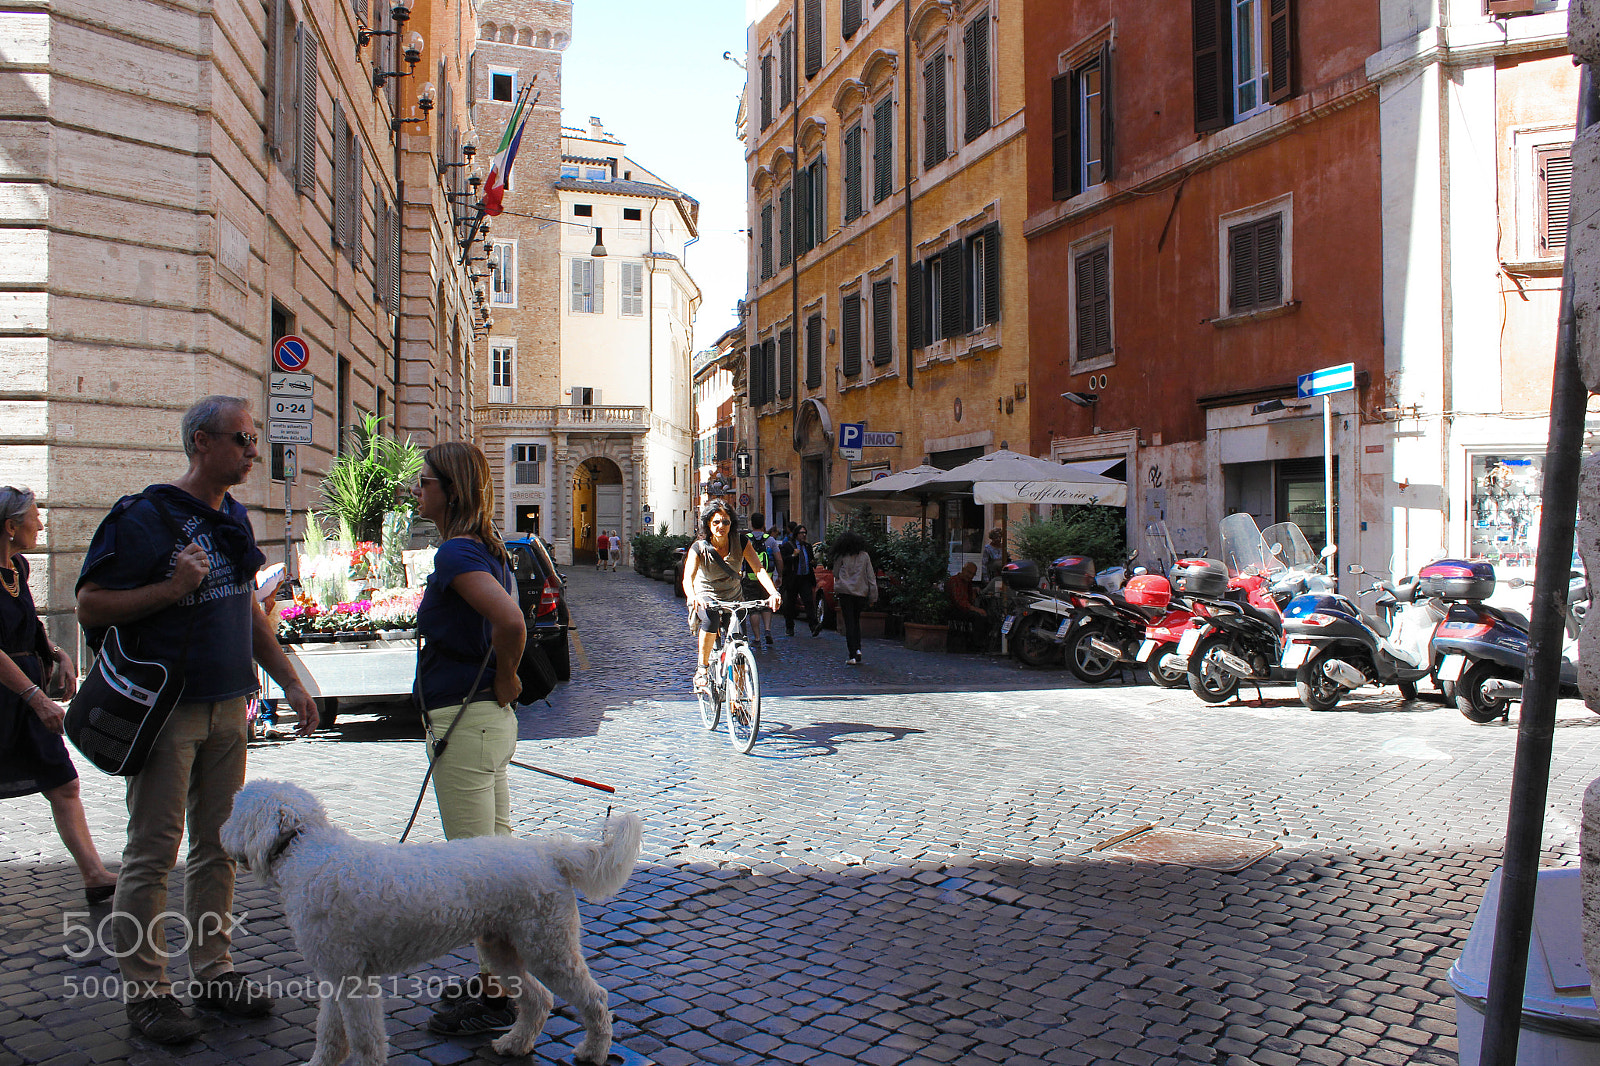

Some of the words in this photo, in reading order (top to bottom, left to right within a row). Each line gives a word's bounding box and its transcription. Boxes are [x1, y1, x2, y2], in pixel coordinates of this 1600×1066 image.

[276, 402, 306, 414] 0-24
[843, 426, 859, 446] P
[1013, 481, 1087, 501] Caffetteria
